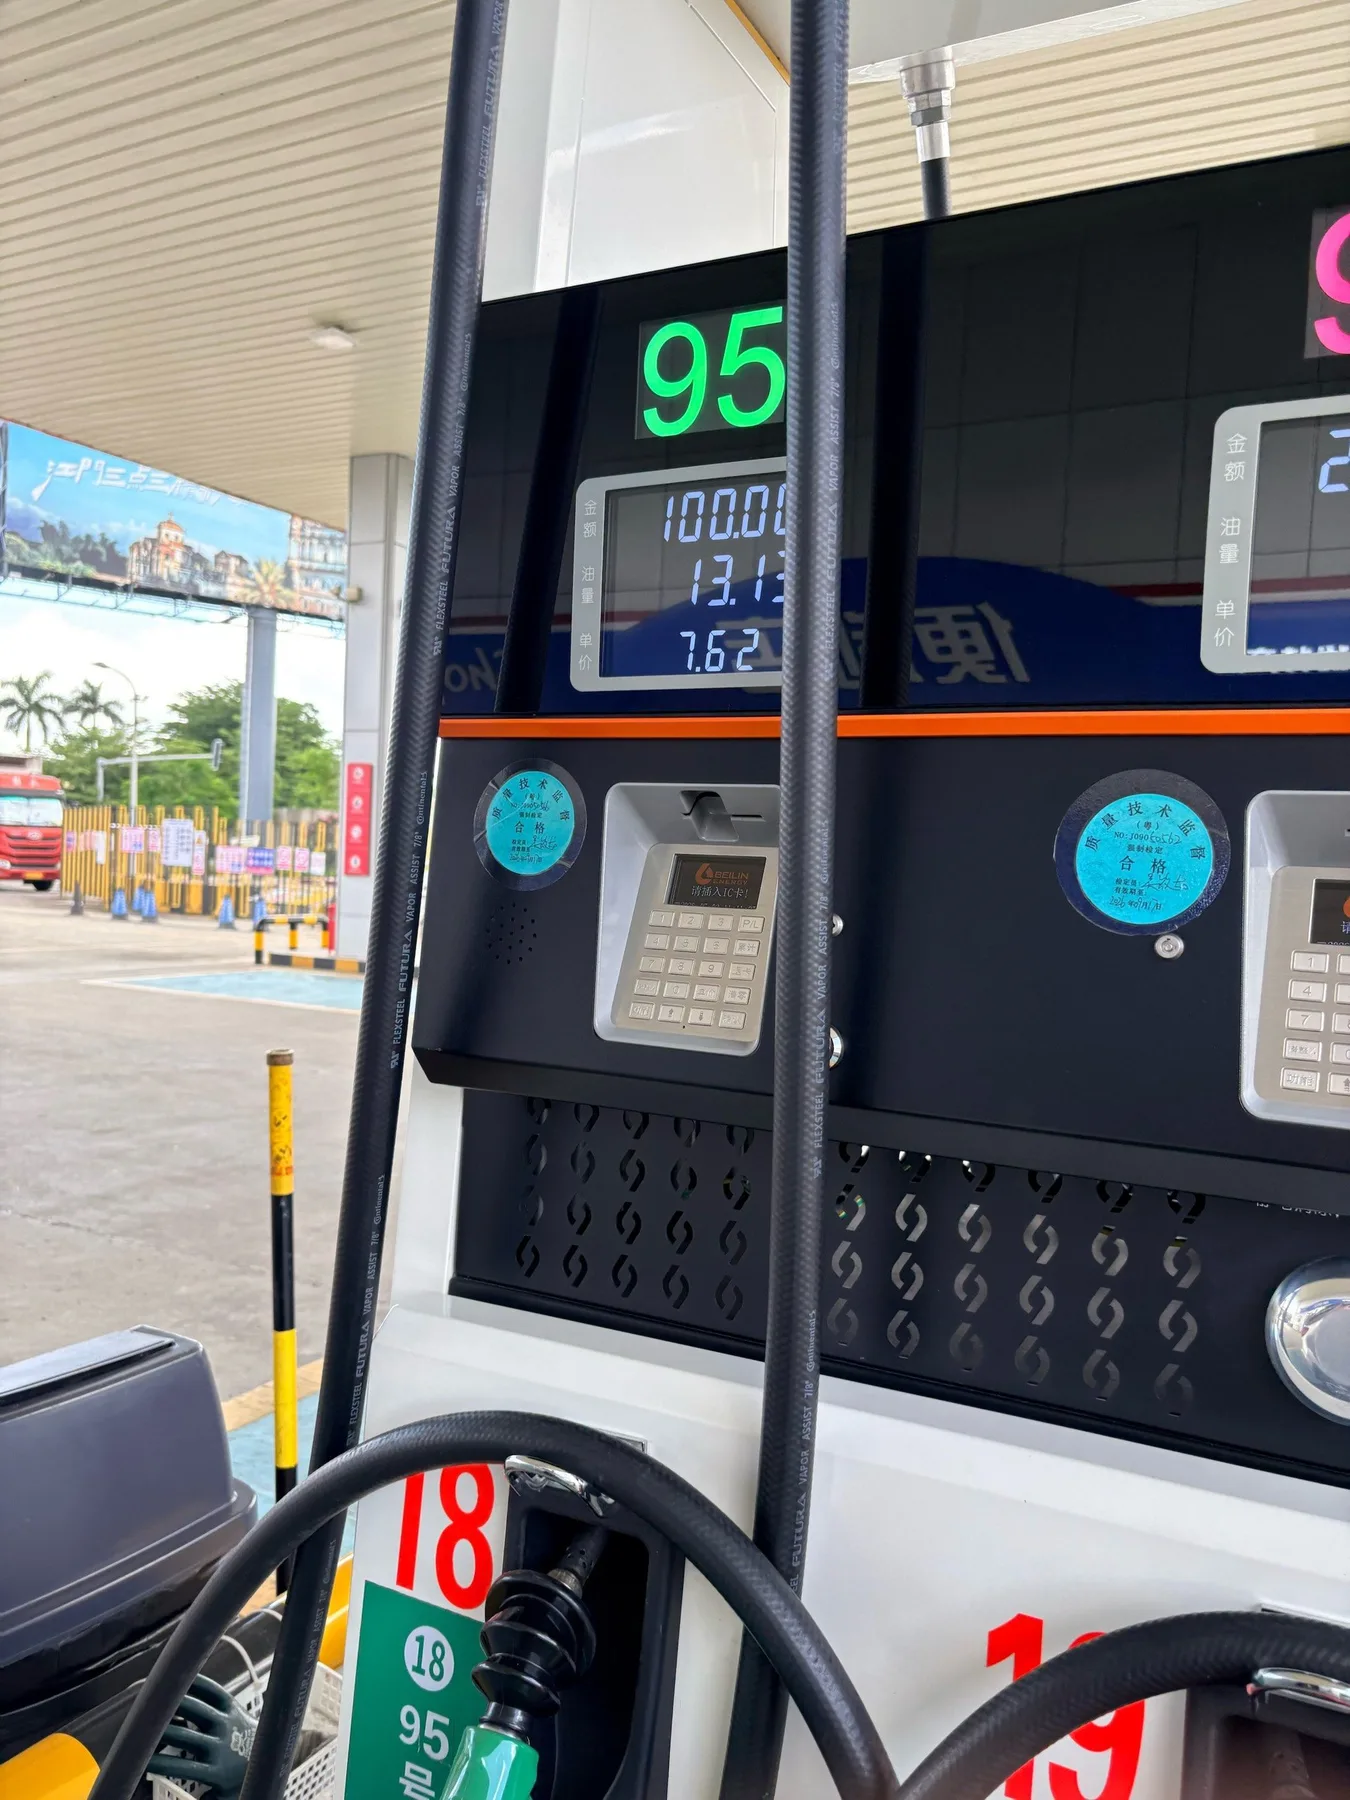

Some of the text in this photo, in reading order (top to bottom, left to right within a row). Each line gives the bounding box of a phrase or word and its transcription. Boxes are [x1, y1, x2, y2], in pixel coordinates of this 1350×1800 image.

[643, 306, 786, 438] 95
[454, 423, 465, 456] ASSIST
[830, 405, 840, 444] ASSIST
[830, 454, 839, 492] VAPOR
[1224, 433, 1248, 481] 金额
[450, 465, 460, 497] VAPOR
[583, 499, 597, 537] 金额
[442, 507, 456, 573] FUTURA
[1219, 516, 1241, 564] 油量
[581, 566, 595, 604] 油量
[690, 550, 786, 607] 13.1
[437, 581, 448, 630] FLEXSTEEL
[1213, 600, 1235, 647] 单价
[579, 633, 592, 671] 单价
[680, 628, 759, 673] 7.62
[514, 821, 546, 834] 合格
[1084, 801, 1206, 861] 质量技术监督
[410, 854, 421, 885] ASSIST
[1118, 855, 1167, 875] 合格
[1126, 844, 1163, 855] 强制检定
[715, 871, 749, 880] BEILIN
[407, 892, 417, 923] VAPOR
[819, 919, 828, 955] ASSIST
[399, 929, 413, 992] FUTURA
[818, 964, 827, 1001] VAPOR
[394, 998, 406, 1045] FLEXSTEEL
[816, 1008, 827, 1084] FUTURA
[814, 1091, 824, 1149] FLEXSTEEL
[369, 1252, 378, 1280] ASSIST
[365, 1286, 375, 1316] VAPOR
[356, 1320, 371, 1378] FUTURA
[351, 1382, 363, 1425] FLEXSTEEL
[803, 1406, 813, 1440] ASSIST
[800, 1449, 810, 1485] VAPOR
[396, 1464, 495, 1610] 18
[793, 1492, 807, 1567] FUTURA
[411, 1634, 446, 1682] 18
[398, 1704, 450, 1761] 95
